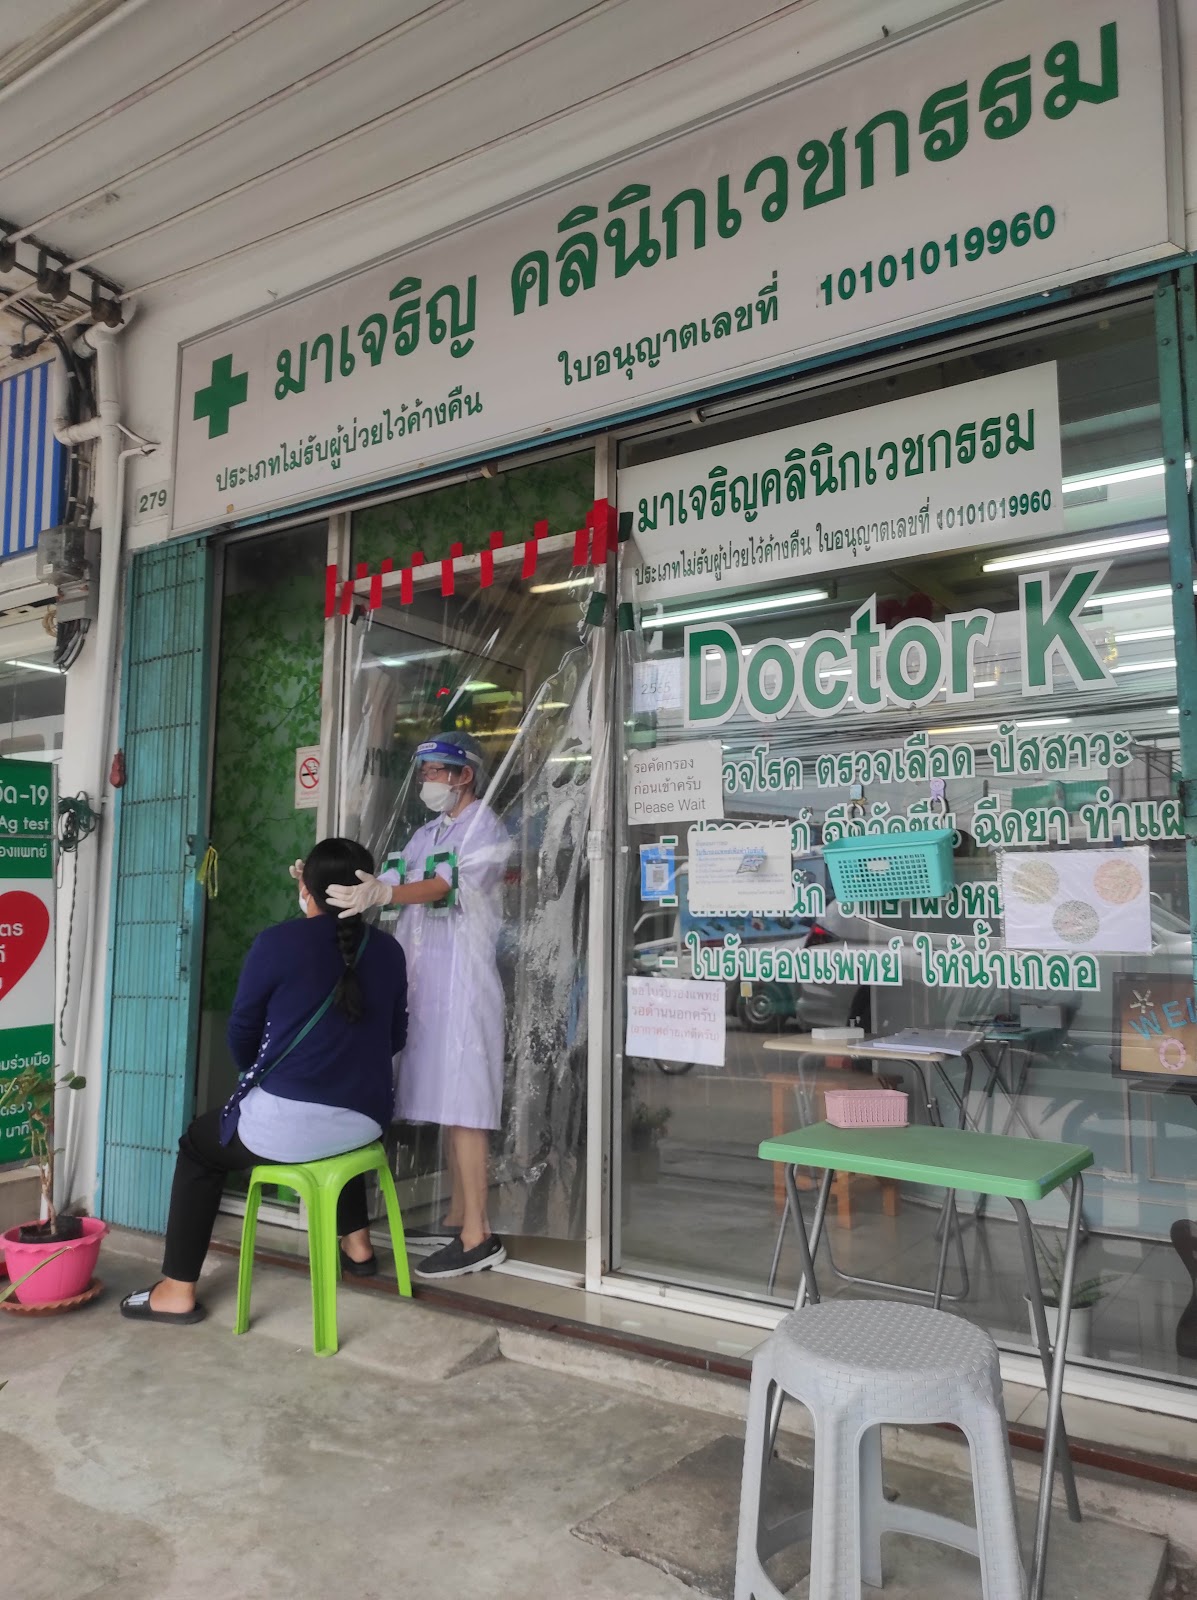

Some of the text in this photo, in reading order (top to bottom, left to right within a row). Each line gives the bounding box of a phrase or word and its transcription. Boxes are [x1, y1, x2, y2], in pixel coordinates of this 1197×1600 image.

[274, 20, 1121, 401] มาเจริญ คลินิกเวชกรรม
[215, 205, 1056, 493] ประเภทไม่รับผู้ป่วยไว้ค้างคืน ใบอนุญาตเลขที่ 10101019960
[139, 489, 167, 513] 279
[636, 408, 1037, 533] มาเจริญคลินิกเวชกรรม
[634, 489, 1052, 586] ประเภทไม่รับผู้ป่วยไว้ค้างคืน ใบอนุญาตเลขที่ 10101019960
[686, 563, 1113, 726] Doctor K
[633, 757, 695, 774] รอคัดกรอง
[633, 775, 702, 795] ก่อนเข้าครับ
[817, 731, 974, 787] ตรวจเลือด
[988, 721, 1131, 775] ปัสสาวะ
[23, 817, 49, 831] test
[634, 797, 707, 814] Please Wait
[972, 794, 1069, 846] ฉีดยา
[686, 920, 1099, 990] ใบรับรองแพทย์ ให้น้ำเกลอ
